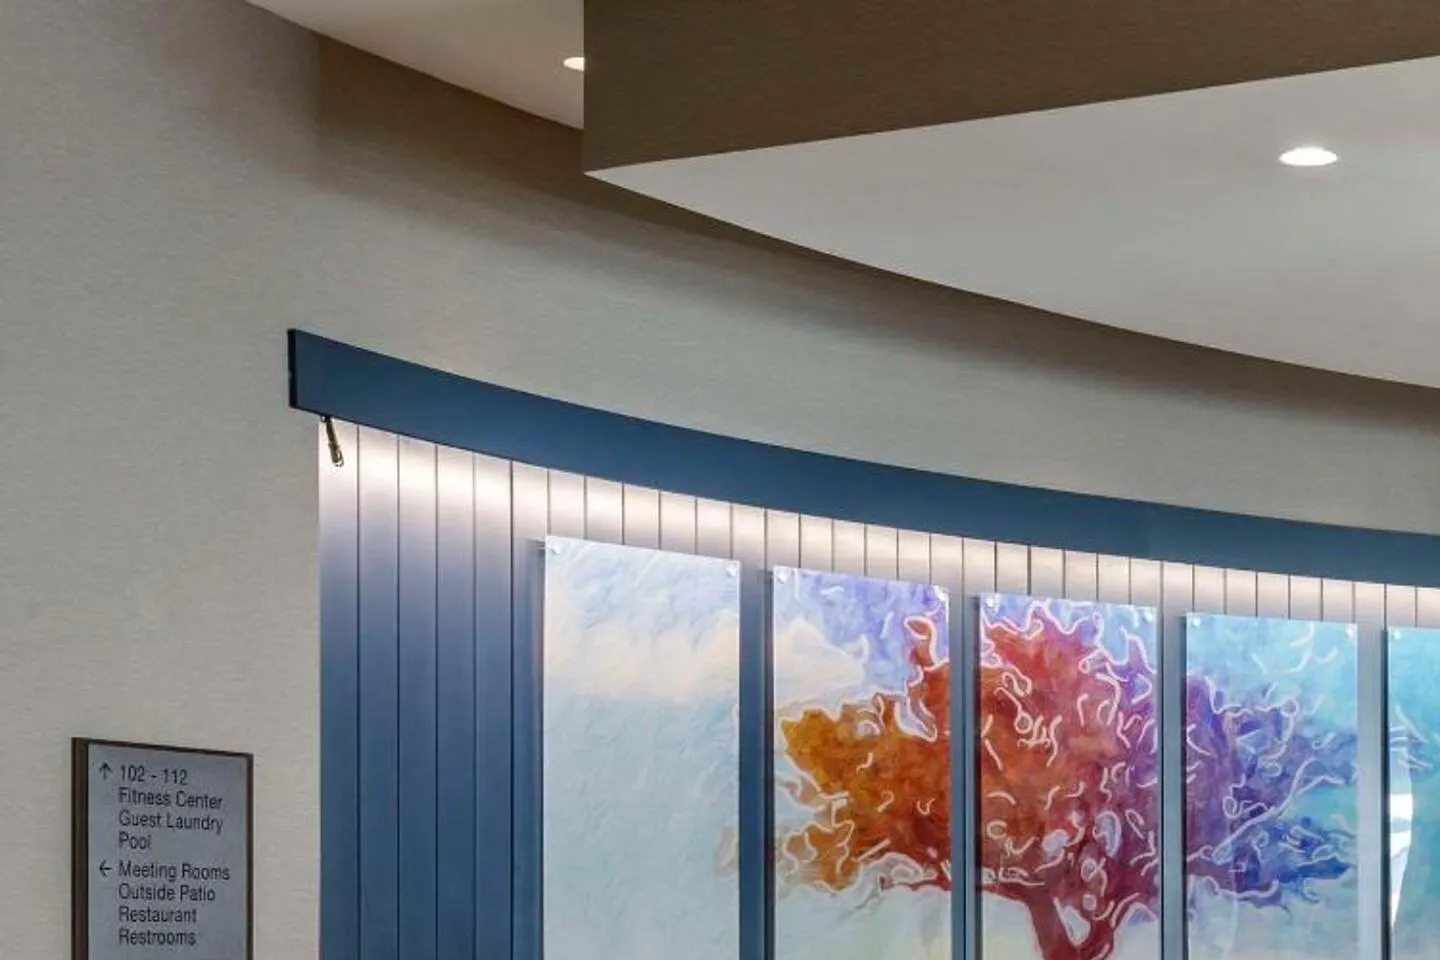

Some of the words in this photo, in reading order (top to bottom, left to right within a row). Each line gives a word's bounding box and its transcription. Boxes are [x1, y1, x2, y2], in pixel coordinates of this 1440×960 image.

[119, 764, 145, 783] 102
[163, 768, 188, 786] 112
[118, 787, 171, 807] Fitness
[175, 791, 224, 809] Center
[118, 809, 162, 828] Guest
[166, 812, 224, 835] Laundry
[118, 832, 152, 850] Pool
[118, 860, 177, 883] Meeting
[182, 863, 231, 881] Rooms
[118, 883, 176, 902] Outside
[180, 885, 216, 902] Patio
[118, 906, 197, 924] Restaurant
[118, 928, 197, 946] Restrooms
